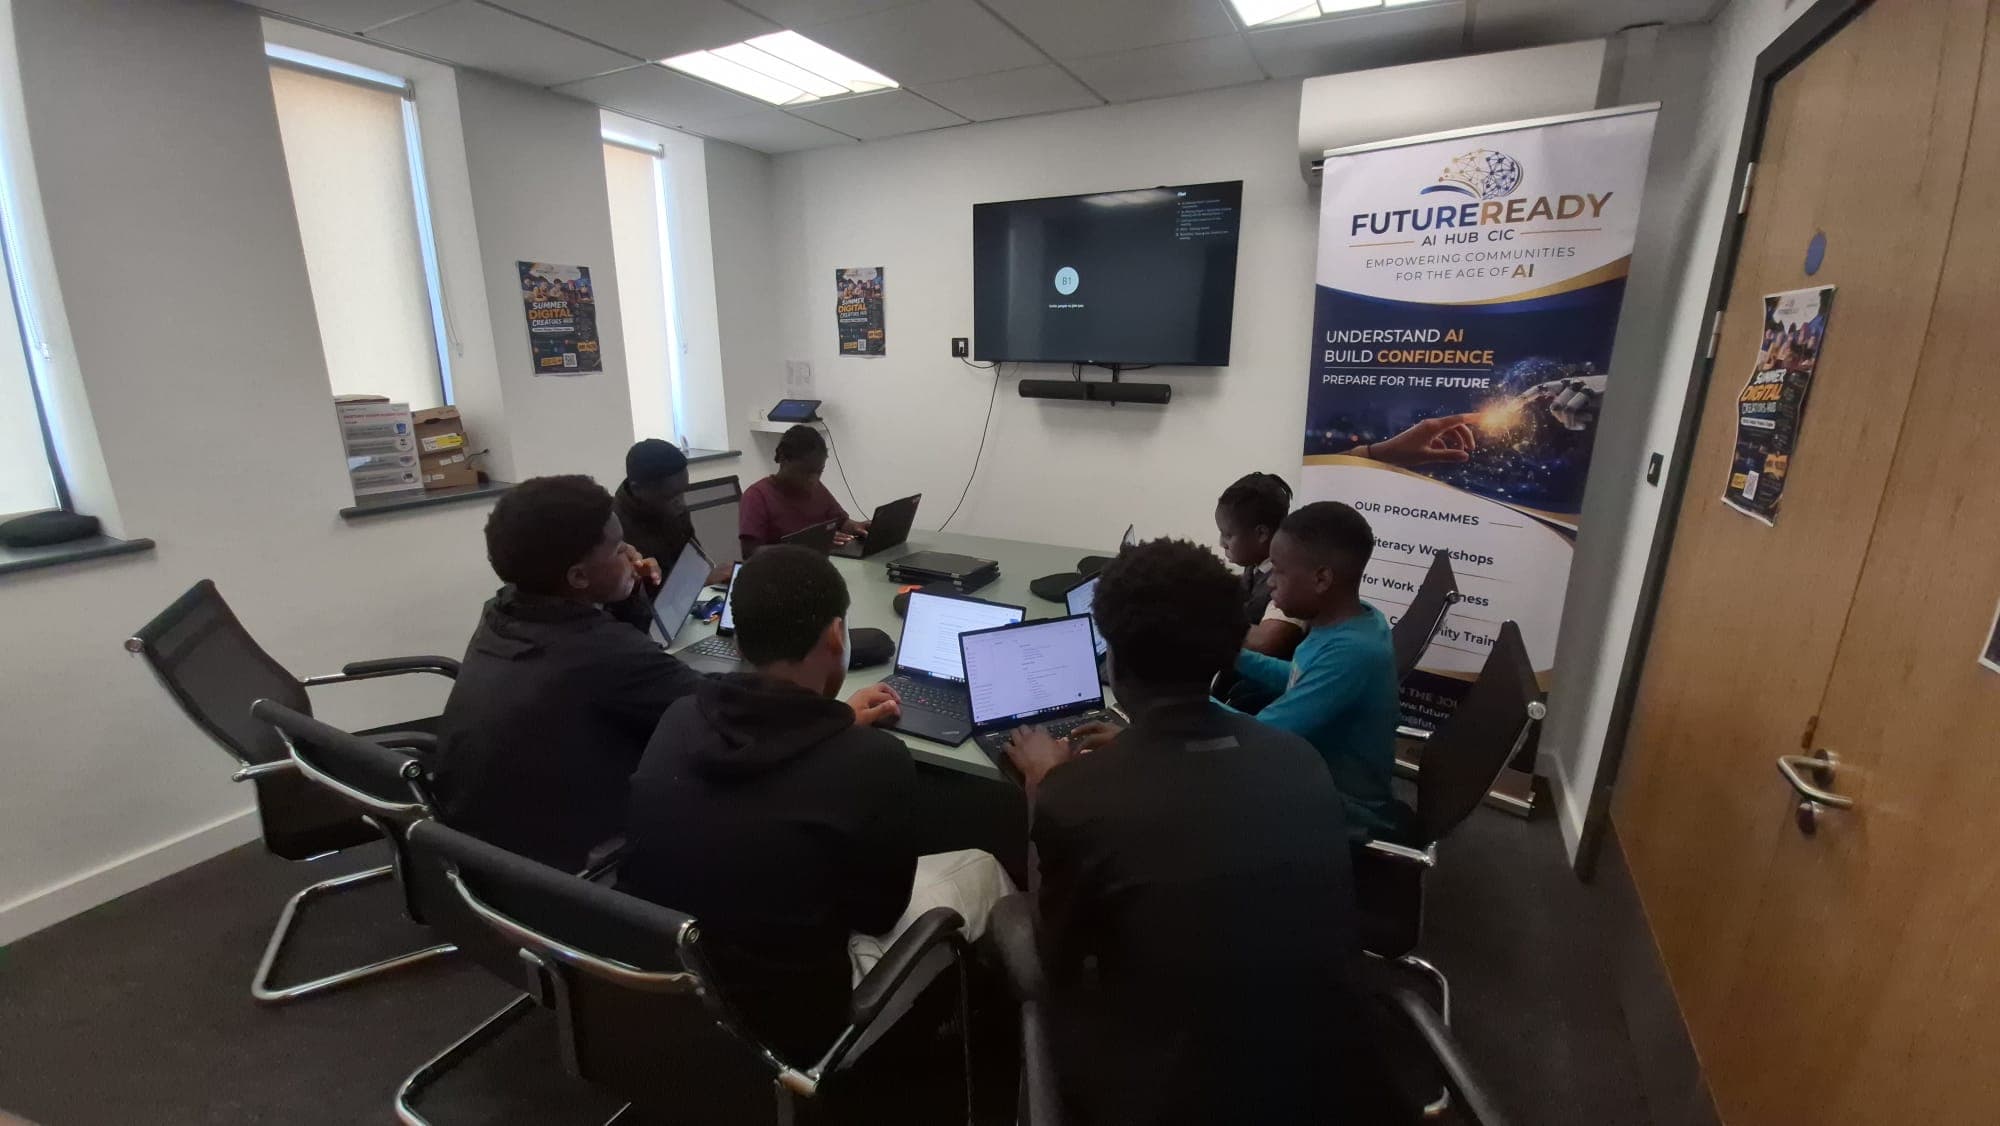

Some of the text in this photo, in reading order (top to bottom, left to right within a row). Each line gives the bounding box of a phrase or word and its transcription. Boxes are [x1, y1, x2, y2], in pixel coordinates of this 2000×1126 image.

[1351, 191, 1614, 236] FUTUREREADY
[1421, 229, 1515, 247] AI HUB CIC
[1365, 246, 1576, 269] EMPOWERING COMMUNITIES
[1395, 264, 1534, 281] FOR THE AGE OF AI
[532, 301, 568, 310] SUMMER
[838, 304, 867, 313] DIGITAL
[528, 309, 574, 320] DIGITAL
[1326, 329, 1464, 344] UNDERSTAND AI
[1324, 349, 1494, 365] BUILD CONFIDENCE
[1322, 374, 1490, 389] PREPARE FOR THE FUTURE
[1741, 383, 1783, 401] DIGITAL
[1354, 500, 1480, 526] OUR PROGRAMMES
[1374, 536, 1494, 566] iteracy Wokshops
[1363, 574, 1379, 585] for
[1382, 577, 1414, 592] Work
[1464, 631, 1497, 647] Train
